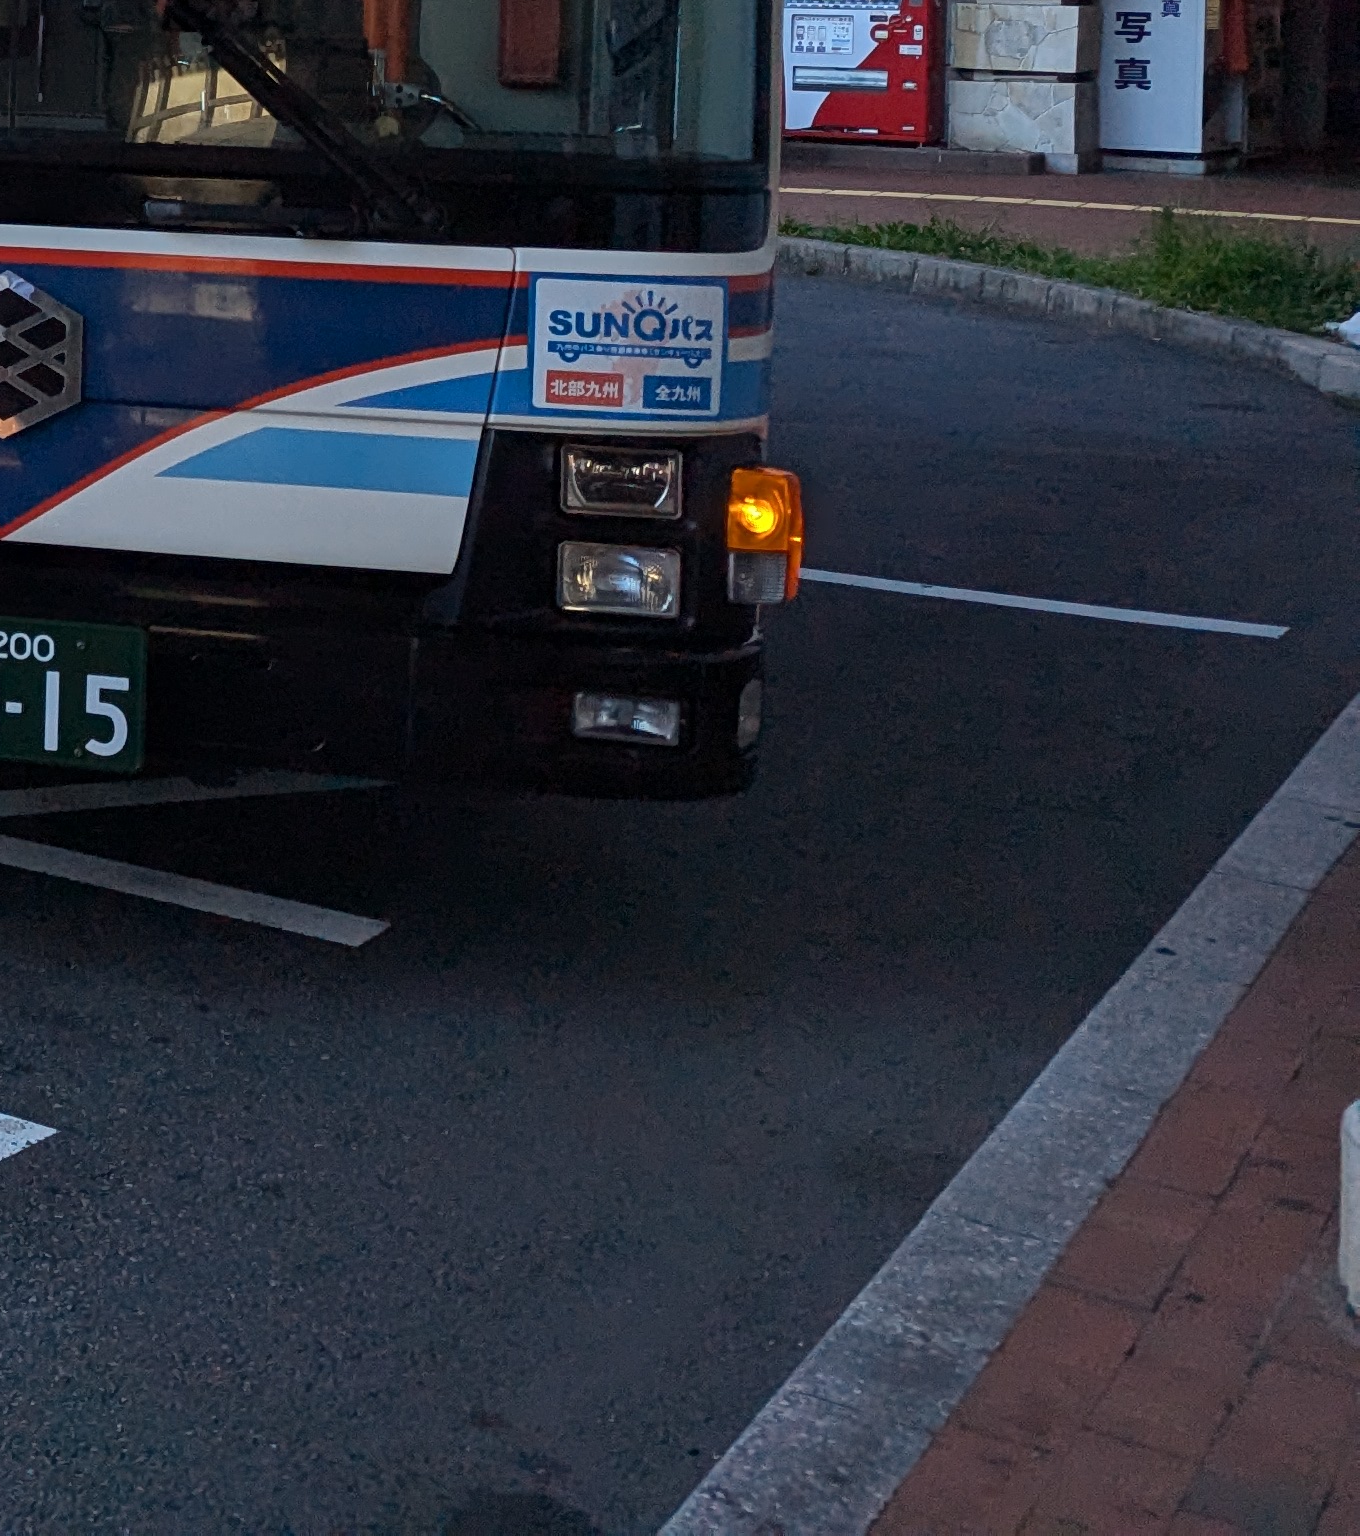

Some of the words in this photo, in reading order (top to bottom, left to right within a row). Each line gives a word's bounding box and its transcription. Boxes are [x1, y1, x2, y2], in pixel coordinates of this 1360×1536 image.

[550, 379, 619, 399] 北部九州
[655, 385, 701, 402] 全九州
